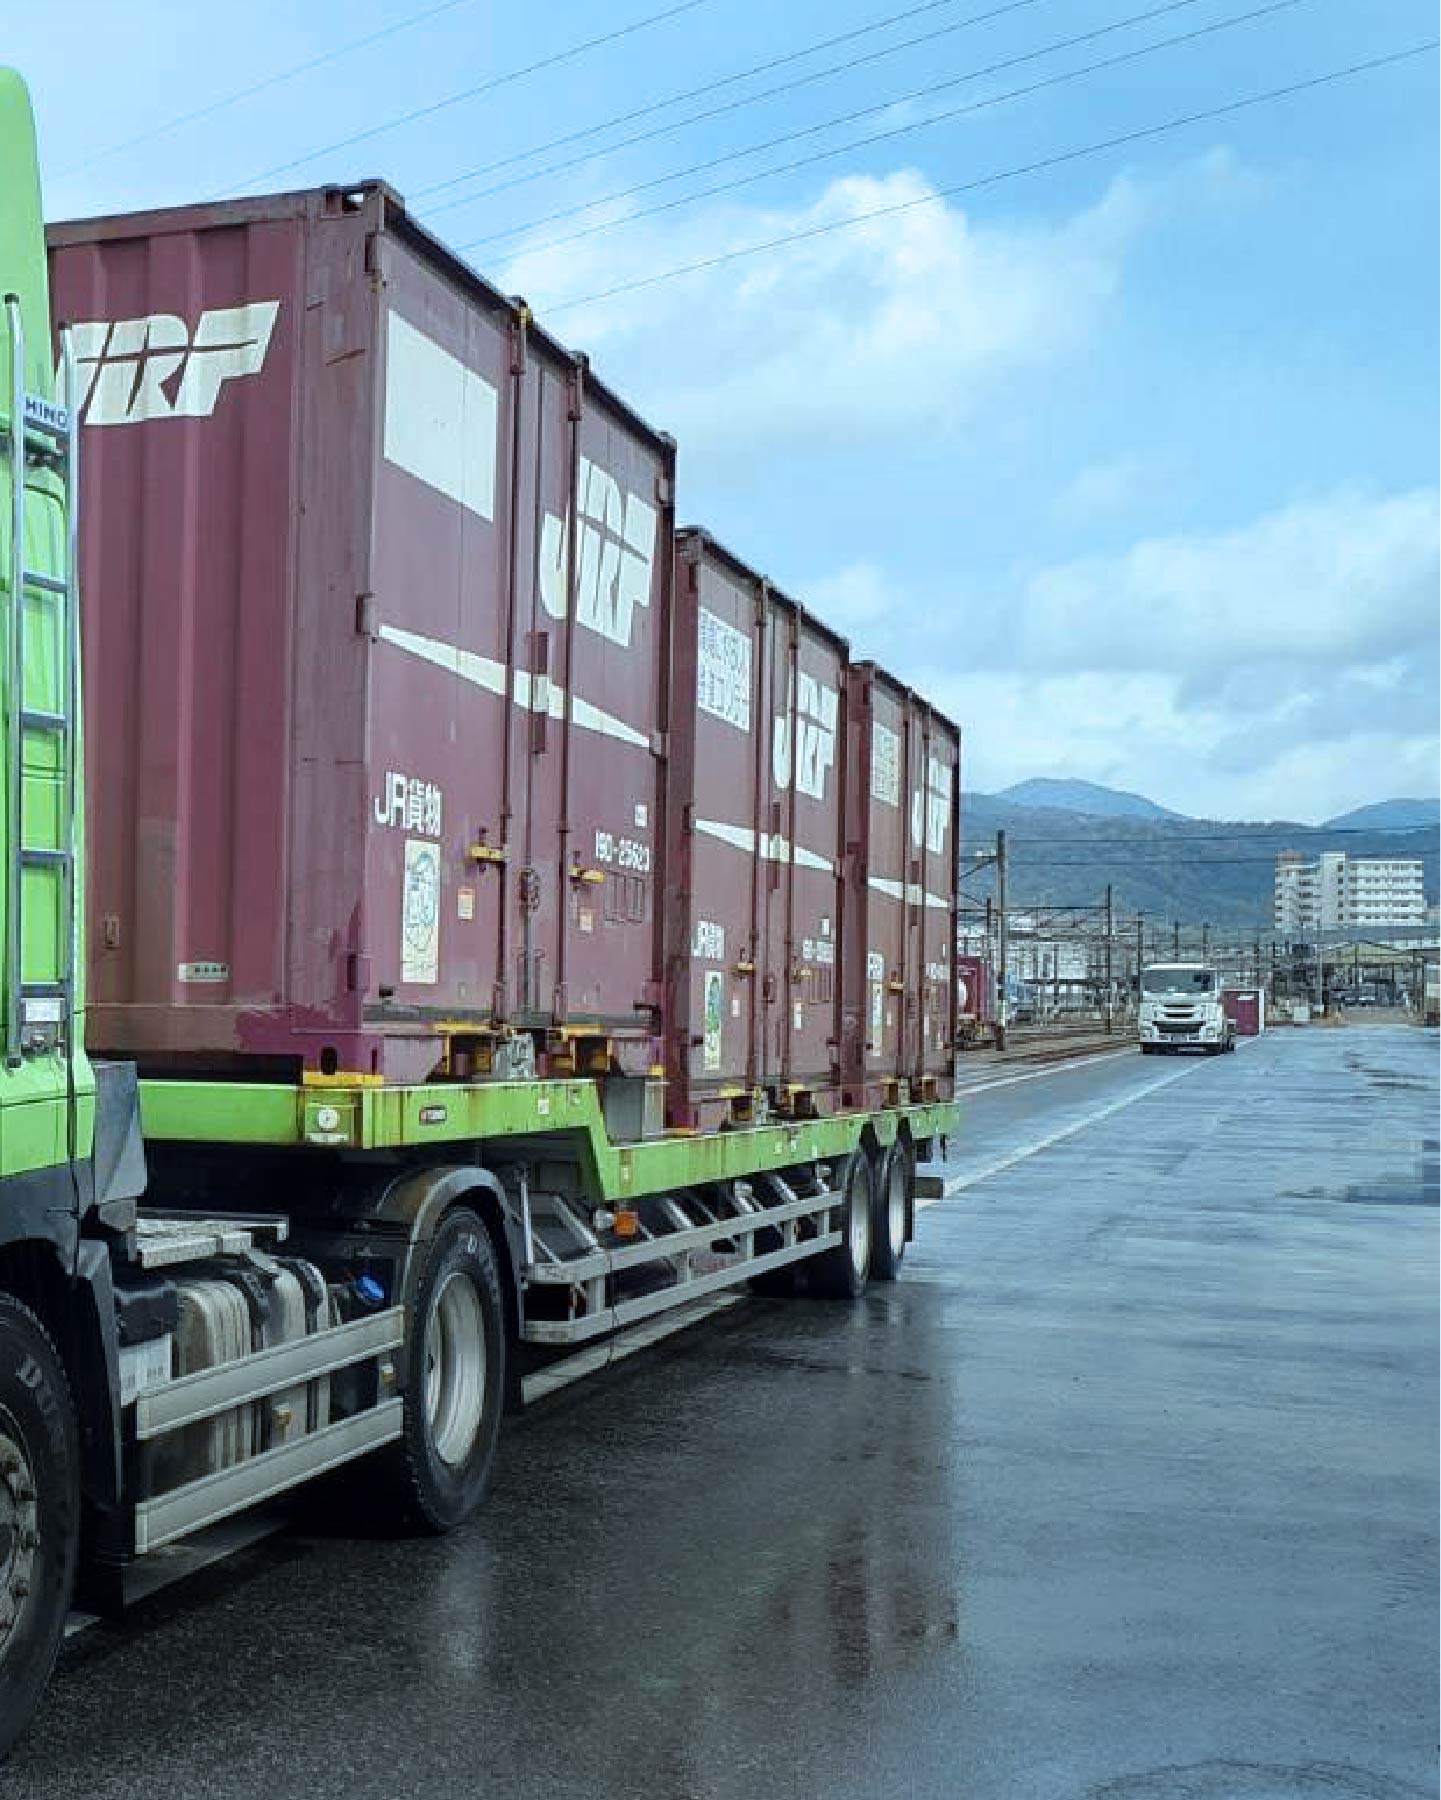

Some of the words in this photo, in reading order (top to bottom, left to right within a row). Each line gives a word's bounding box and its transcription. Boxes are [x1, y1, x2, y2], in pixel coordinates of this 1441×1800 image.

[26, 396, 66, 428] HINO
[540, 456, 656, 648] JRF
[375, 771, 442, 836] JR貨物
